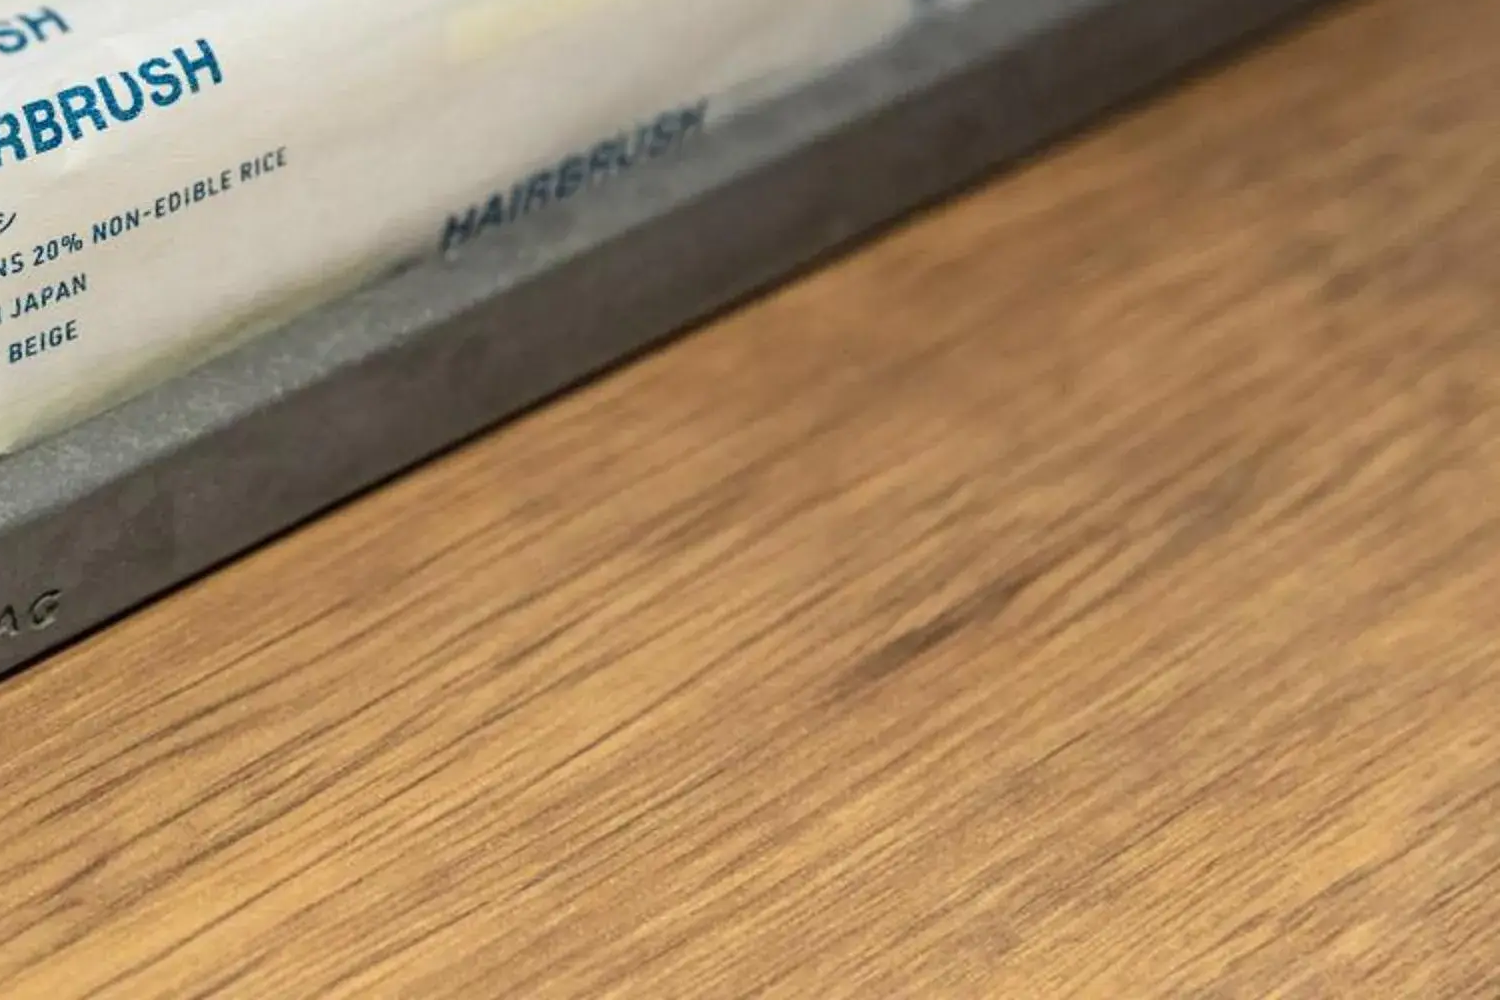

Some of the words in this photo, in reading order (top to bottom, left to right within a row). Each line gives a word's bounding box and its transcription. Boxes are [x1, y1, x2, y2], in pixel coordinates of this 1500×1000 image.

[32, 233, 84, 267] 20%
[91, 169, 233, 245] NON-EDIBLE
[239, 146, 288, 182] RICE
[10, 272, 87, 319] JAPAN
[8, 320, 79, 364] BEIGE
